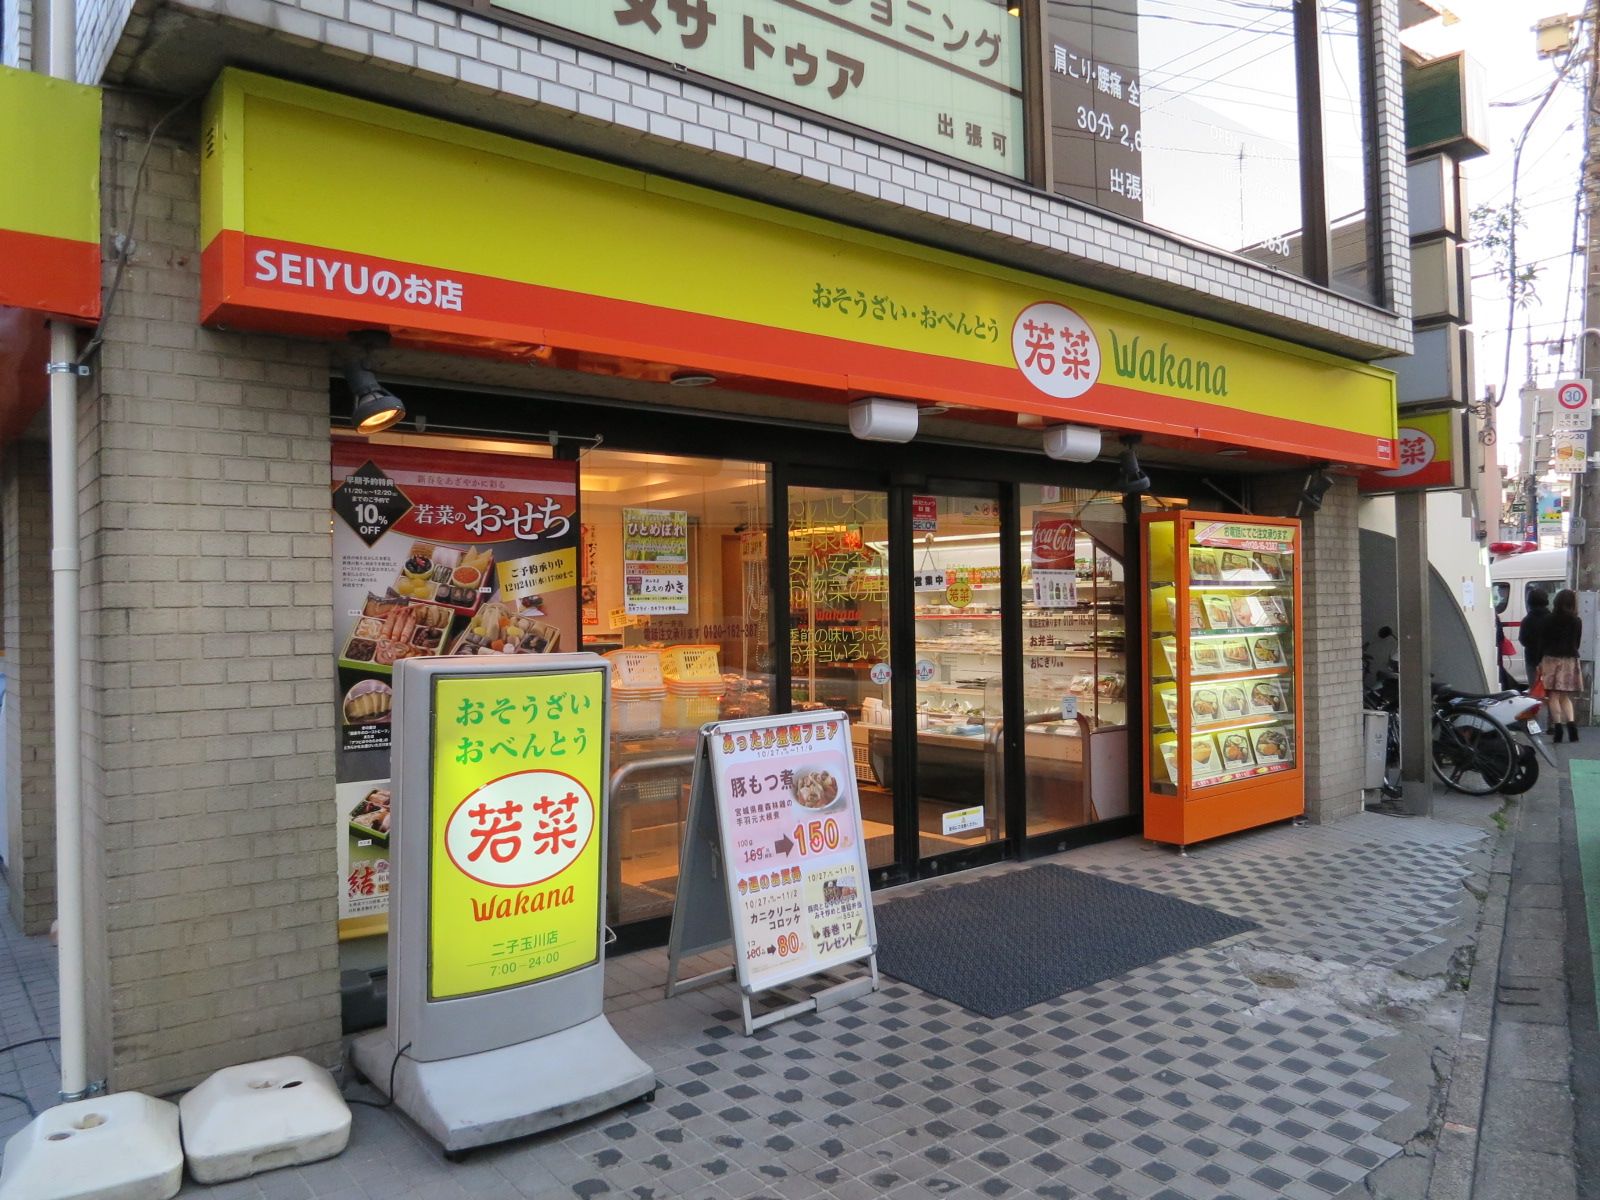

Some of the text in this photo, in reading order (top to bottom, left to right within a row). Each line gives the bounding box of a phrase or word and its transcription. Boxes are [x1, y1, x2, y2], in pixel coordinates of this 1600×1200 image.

[828, 0, 1001, 67] ョニング
[938, 113, 1006, 157] 出張可
[1077, 106, 1114, 140] 30分
[255, 249, 463, 312] SEIYUのお店
[812, 282, 999, 344] おそうざい・おべんとう
[1023, 318, 1091, 380] 若菜
[1108, 328, 1228, 397] Wakana
[1565, 390, 1581, 402] 30
[355, 503, 388, 525] 10%
[360, 525, 381, 535] OFF
[628, 522, 686, 537] ひとめぼれ
[914, 575, 943, 587] 営業中
[949, 588, 969, 602] 若菜
[1030, 634, 1054, 648] お弁当
[456, 691, 592, 726] おそうざい
[455, 728, 589, 765] おべんとう
[731, 769, 794, 799] 豚もつ煮
[467, 792, 580, 864] 若菜
[794, 818, 839, 856] 150
[470, 885, 575, 922] Wakana
[751, 904, 800, 925] カニクリーム
[769, 914, 800, 930] コロッケ
[823, 923, 839, 938] 春巻
[492, 930, 559, 956] 二子玉川店
[777, 932, 799, 957] 80
[817, 934, 855, 954] プレゼント
